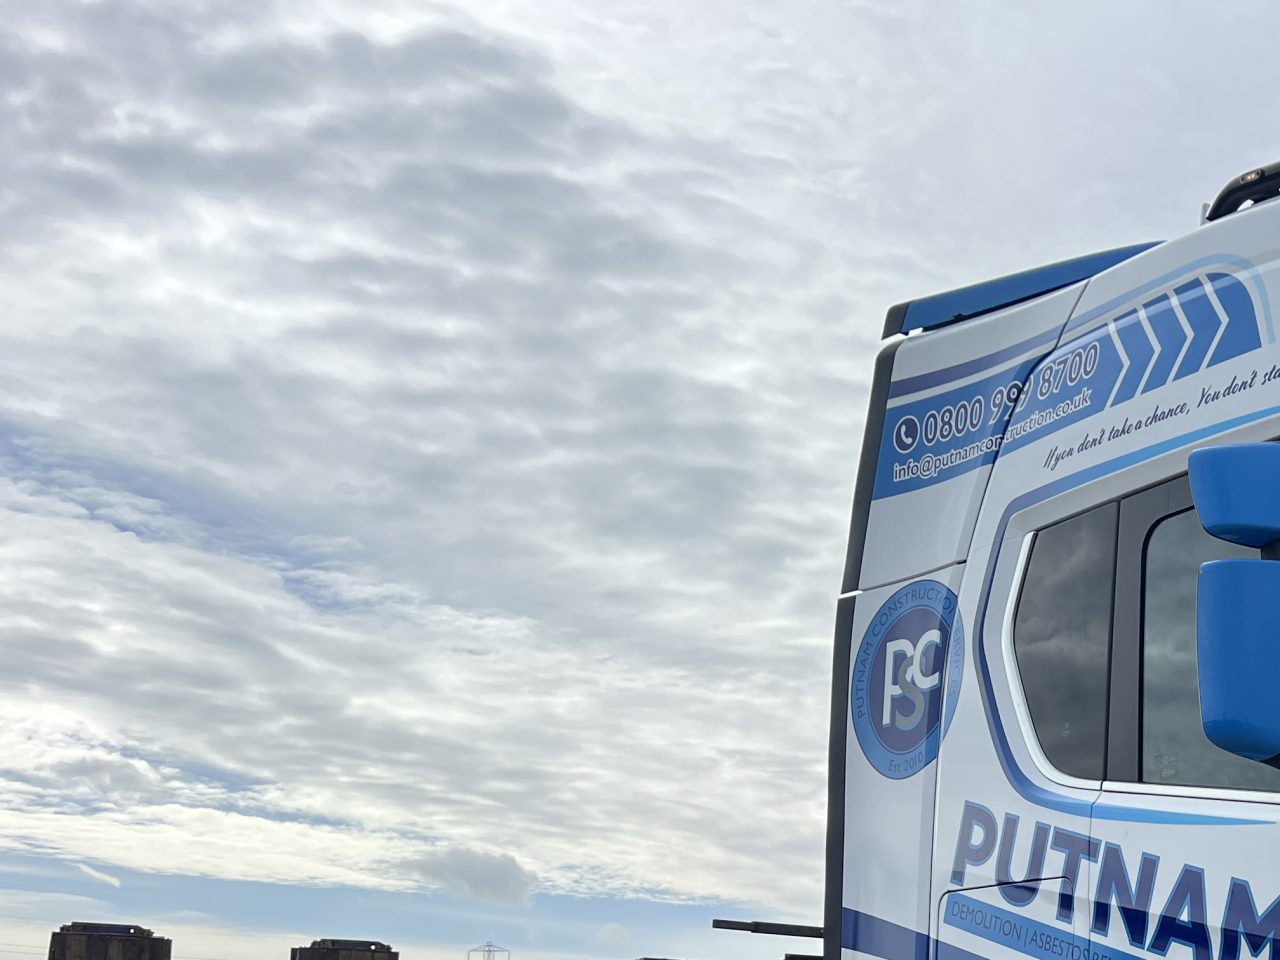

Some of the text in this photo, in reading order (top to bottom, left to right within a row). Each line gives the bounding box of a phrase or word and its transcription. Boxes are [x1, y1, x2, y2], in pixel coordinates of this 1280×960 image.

[893, 387, 1092, 482] info@putnamcontruction.co.uk
[923, 341, 1100, 447] 0800 999 8700
[1077, 427, 1105, 454] don't
[1108, 417, 1133, 442] take
[1134, 419, 1144, 431] a
[1197, 384, 1221, 408] You
[1223, 369, 1259, 398] don't
[857, 641, 874, 719] PUTNAM
[903, 751, 924, 771] 2010
[951, 900, 1022, 941] DEMOLITION
